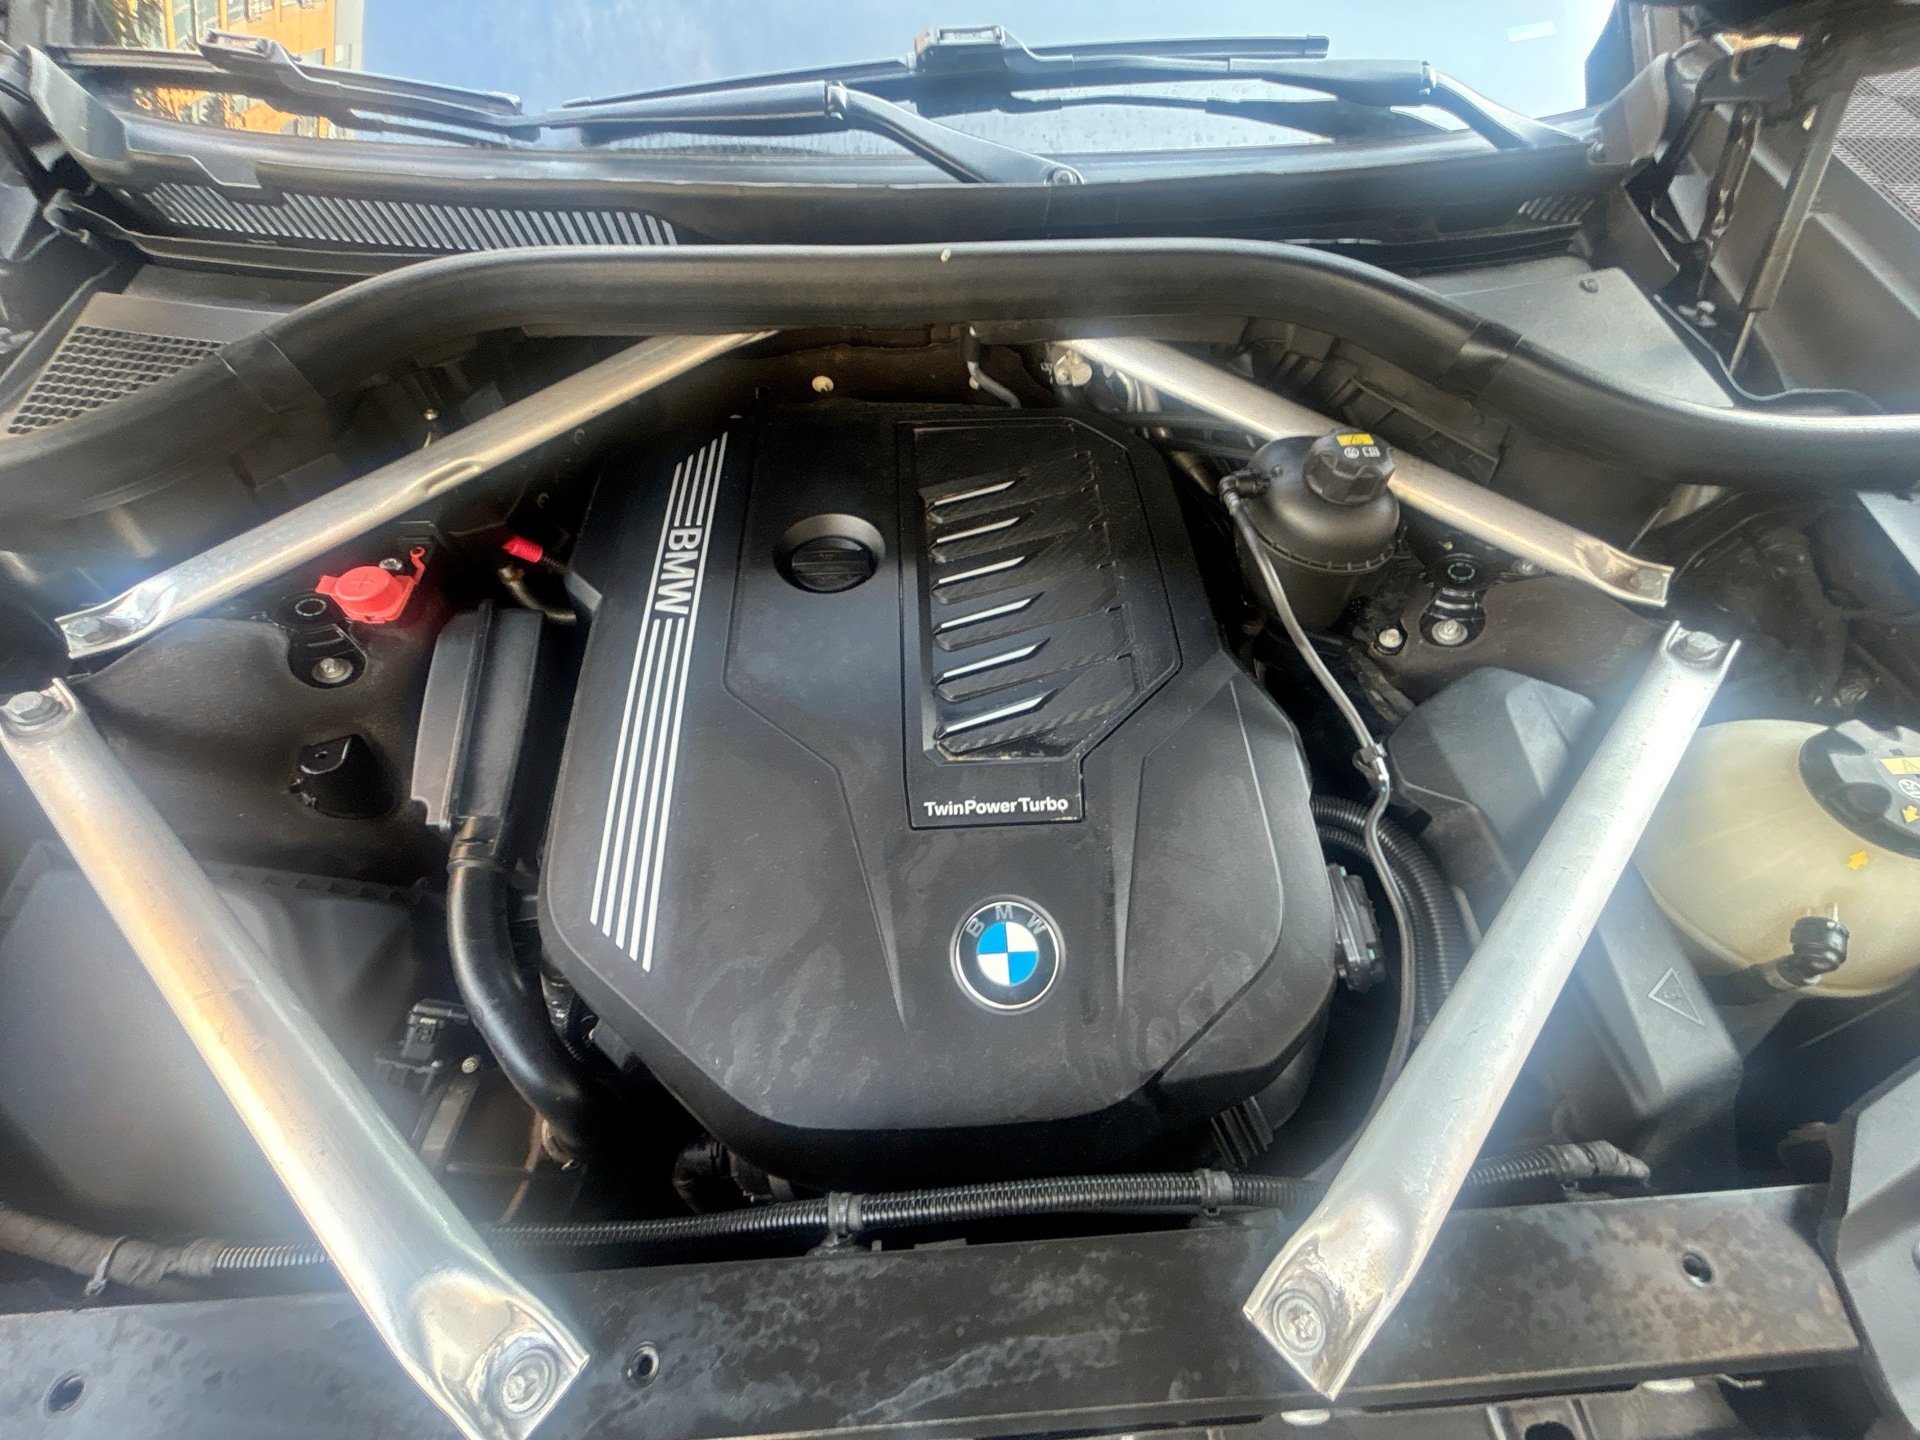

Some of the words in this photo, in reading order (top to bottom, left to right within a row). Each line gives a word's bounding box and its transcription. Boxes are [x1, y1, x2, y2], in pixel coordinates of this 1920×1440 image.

[655, 527, 703, 615] BMW
[1018, 796, 1069, 813] Turbo
[966, 904, 1047, 938] BMW
